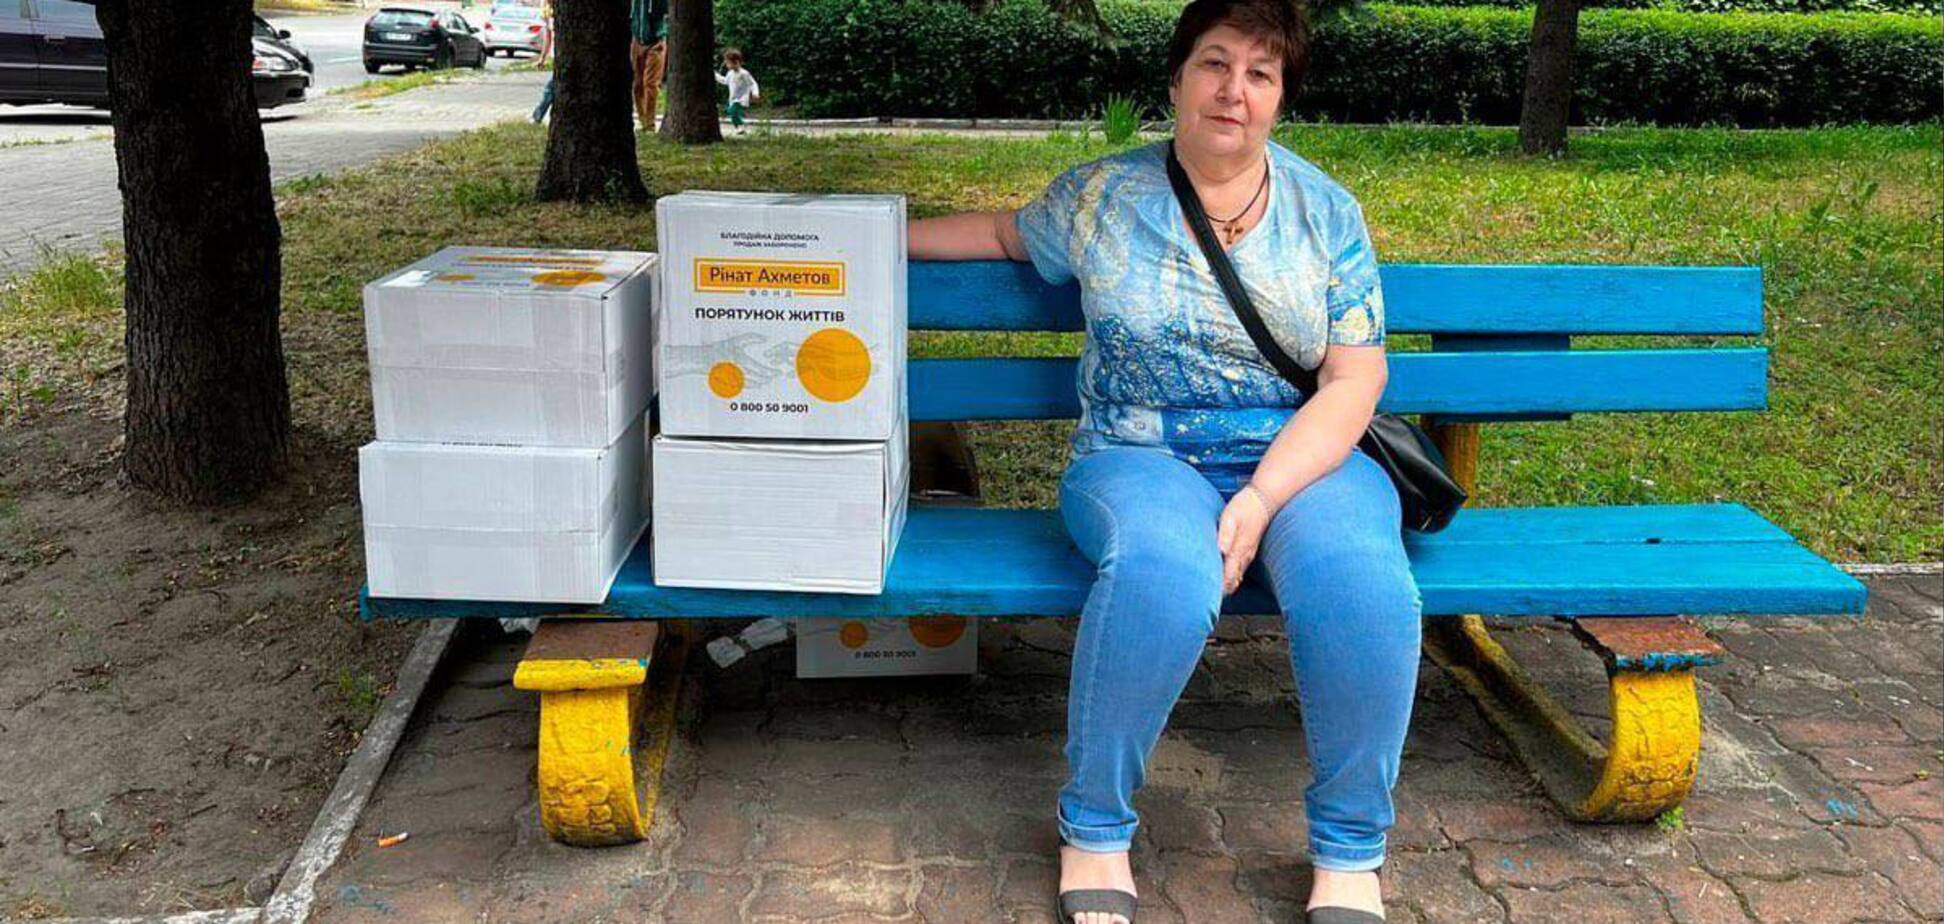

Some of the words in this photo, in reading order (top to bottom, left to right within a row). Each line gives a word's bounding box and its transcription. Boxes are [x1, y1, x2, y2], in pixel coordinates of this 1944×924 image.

[773, 232, 820, 241] ДОПОМОГА
[709, 266, 753, 283] Рінат
[758, 267, 830, 285] Ахметов
[695, 307, 785, 321] ПОРЯТУНОК
[788, 309, 845, 322] ЖИТТІВ
[730, 402, 739, 411] 0
[740, 402, 763, 412] 800
[765, 402, 780, 413] 50
[781, 403, 808, 413] 9001
